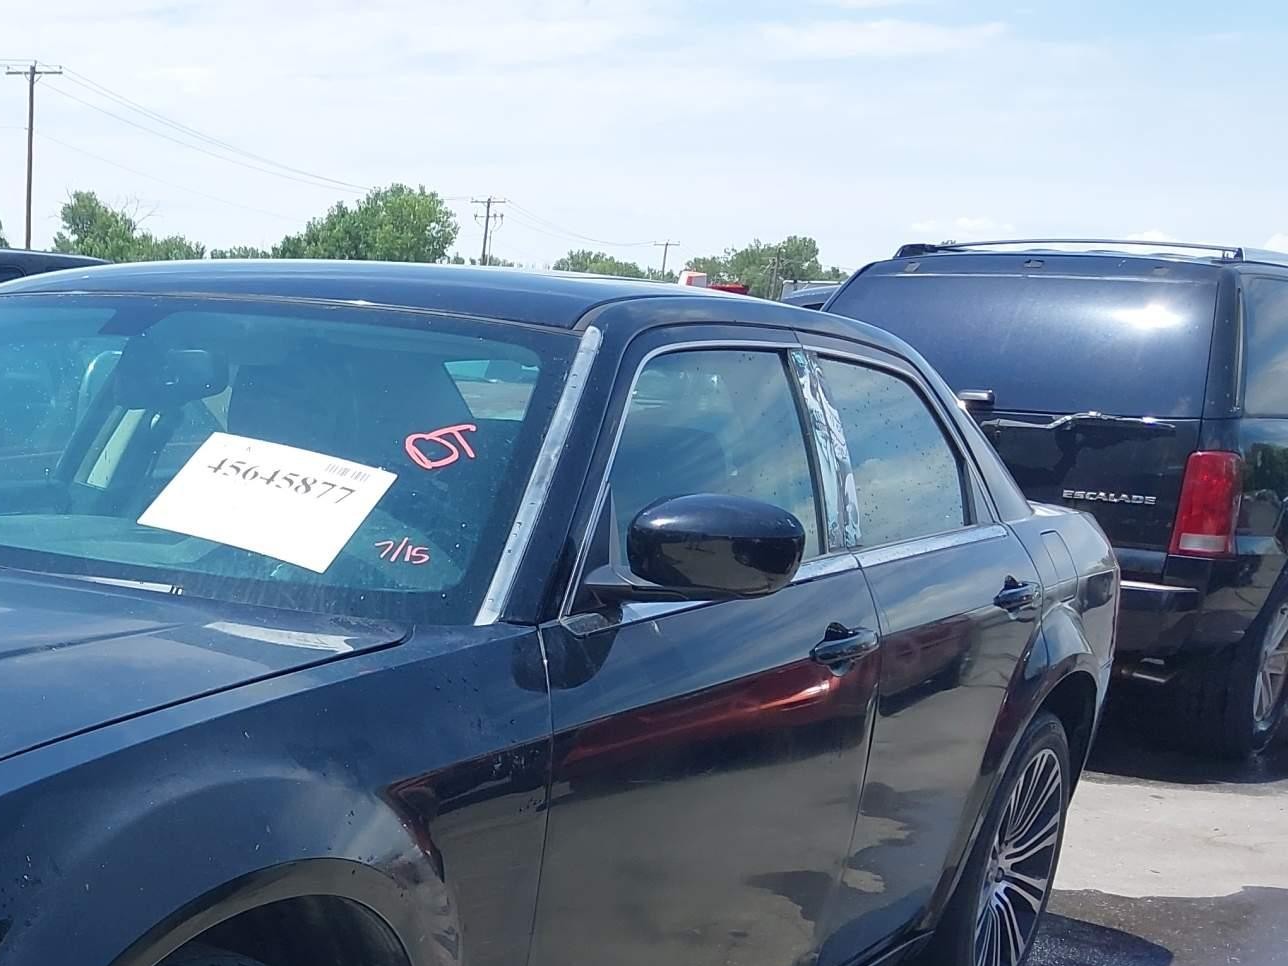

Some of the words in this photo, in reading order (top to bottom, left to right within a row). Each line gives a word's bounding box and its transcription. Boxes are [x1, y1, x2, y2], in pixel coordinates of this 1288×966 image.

[207, 457, 356, 504] 45645877
[1062, 489, 1157, 505] ESCALADE
[374, 536, 430, 565] 7/15
